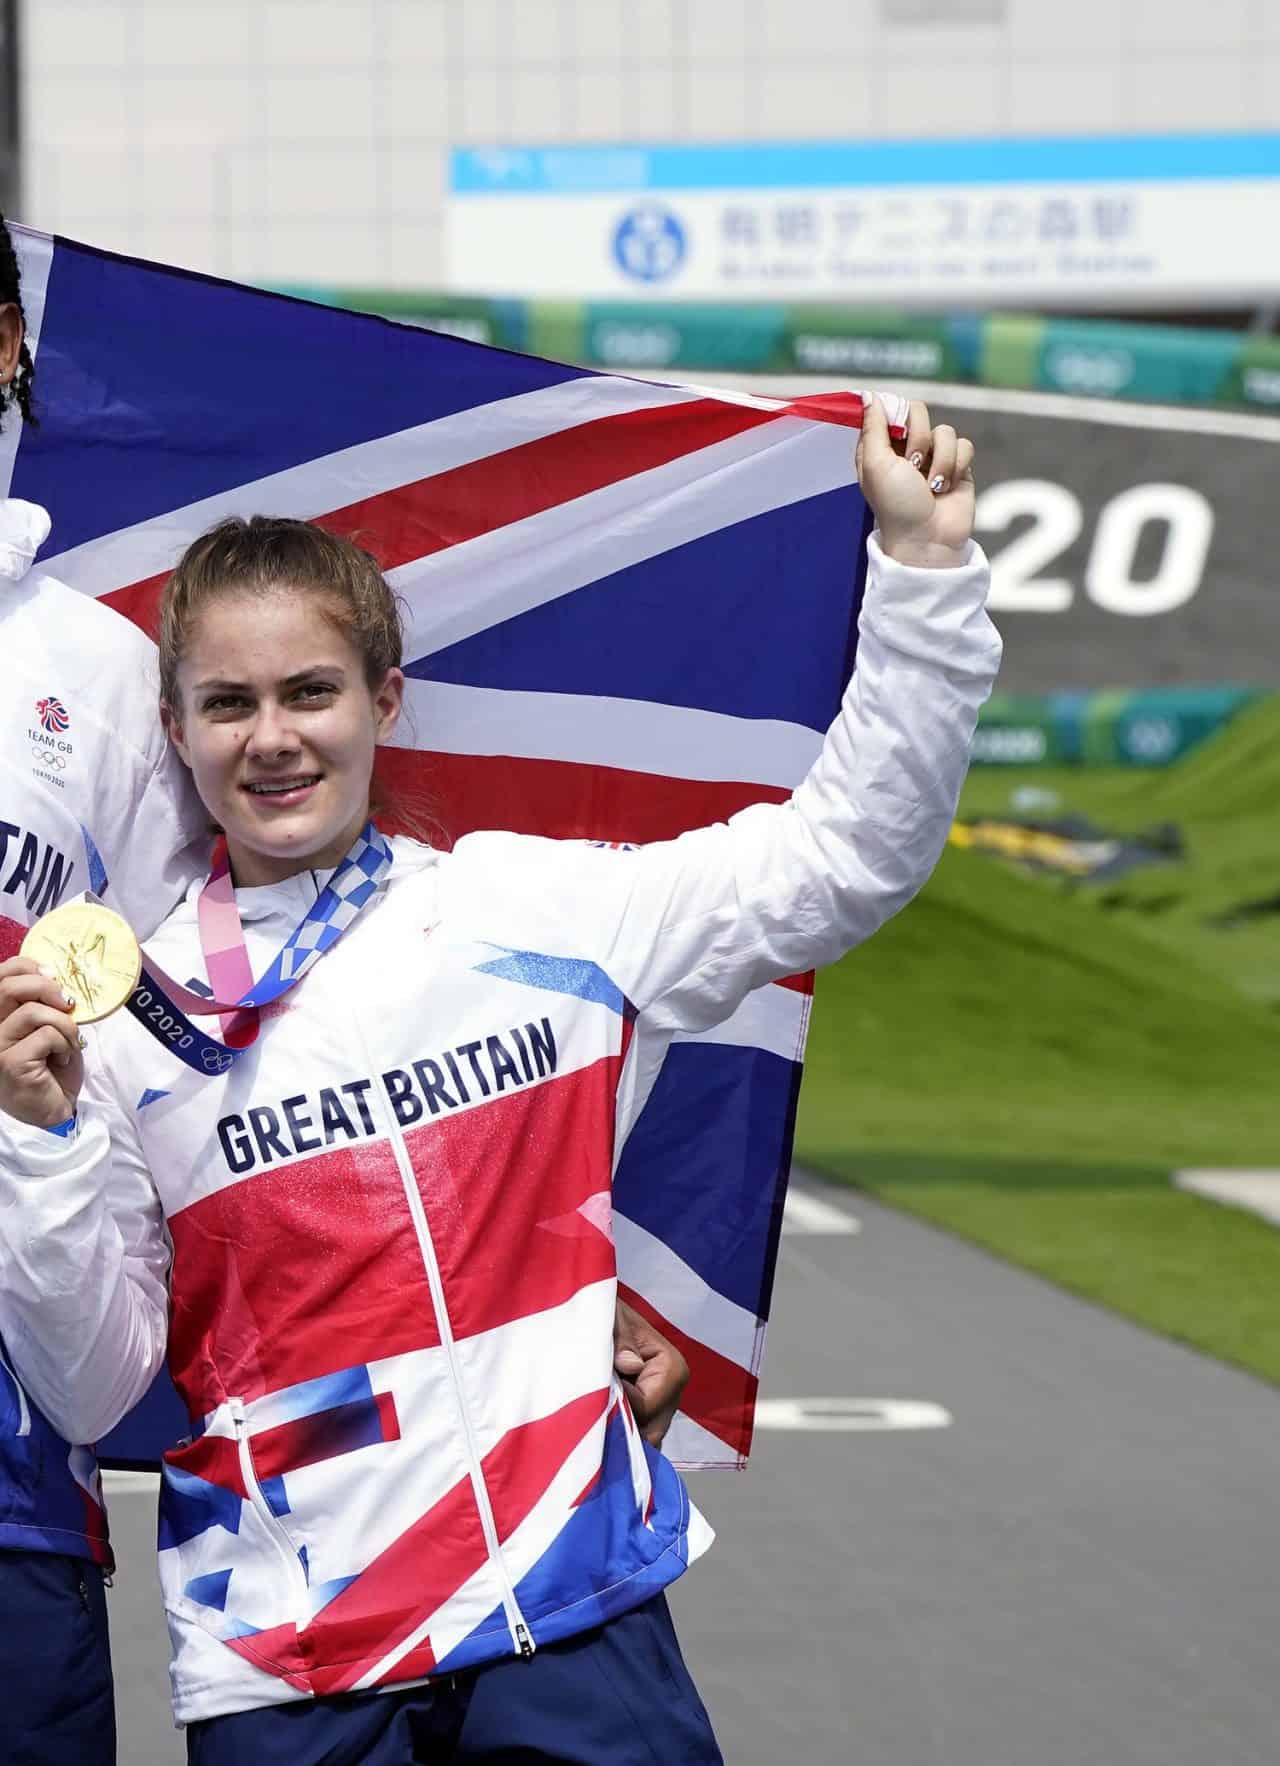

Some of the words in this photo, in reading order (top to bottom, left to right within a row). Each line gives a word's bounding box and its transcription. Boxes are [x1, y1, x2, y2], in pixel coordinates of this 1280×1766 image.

[27, 729, 55, 748] TEAM
[57, 741, 73, 754] GB
[147, 1005, 194, 1049] 2020
[216, 1079, 377, 1174] GREAT
[381, 1017, 558, 1127] BRITAIN
